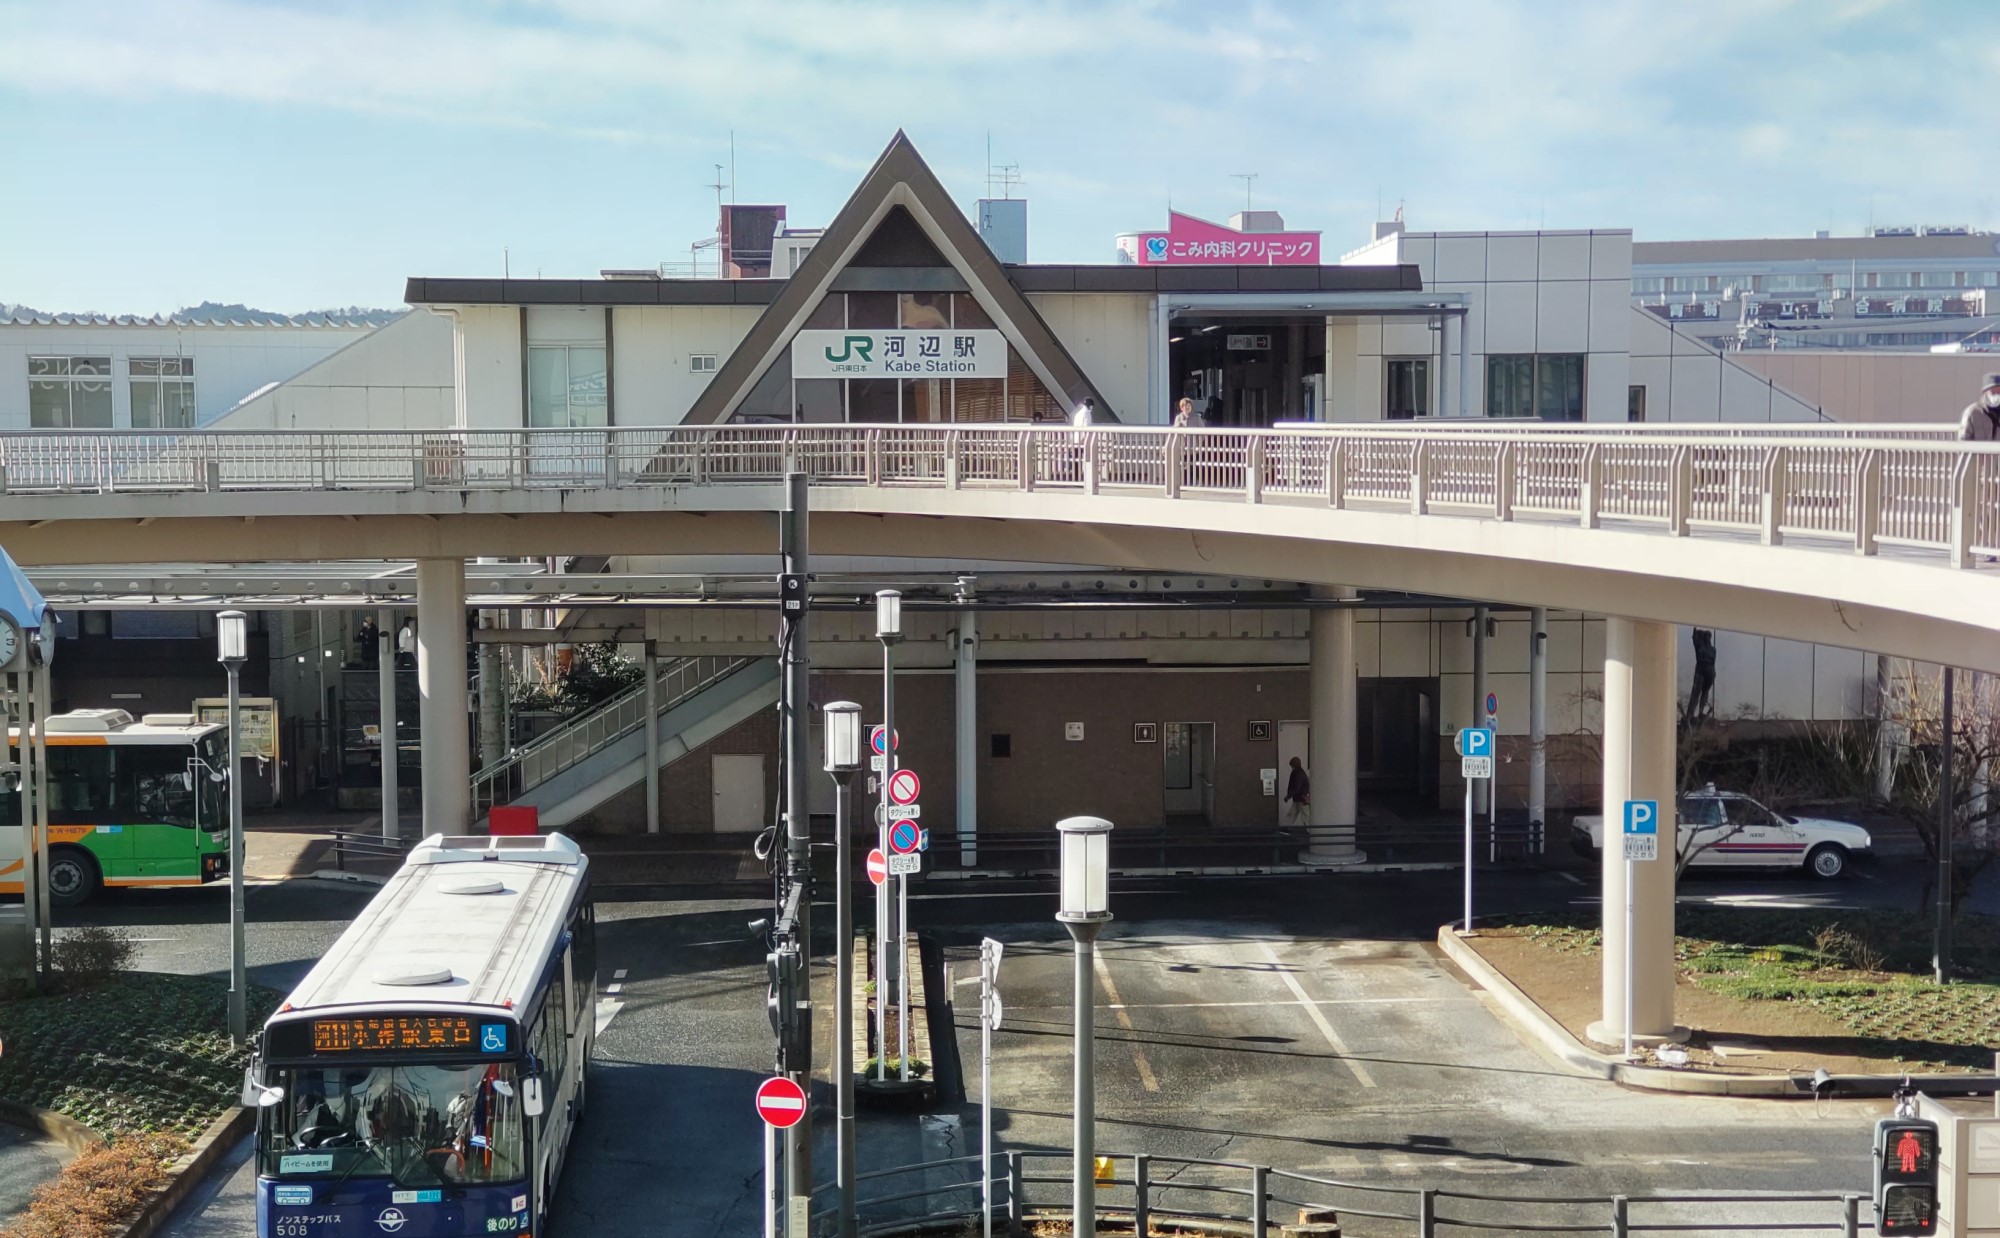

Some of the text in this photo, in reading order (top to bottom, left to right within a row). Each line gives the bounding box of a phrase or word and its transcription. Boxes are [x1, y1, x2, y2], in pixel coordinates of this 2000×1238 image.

[1172, 240, 1313, 258] こみ内科クリニック
[825, 335, 873, 362] JR
[883, 336, 976, 358] 河辺駅
[831, 364, 868, 373] JR東日本
[885, 360, 976, 372] Kabe Station
[1469, 731, 1486, 754] P
[1631, 804, 1652, 831] P
[276, 1214, 342, 1225] ノンステップバス
[486, 1217, 518, 1232] 後のり
[276, 1225, 308, 1236] 508
